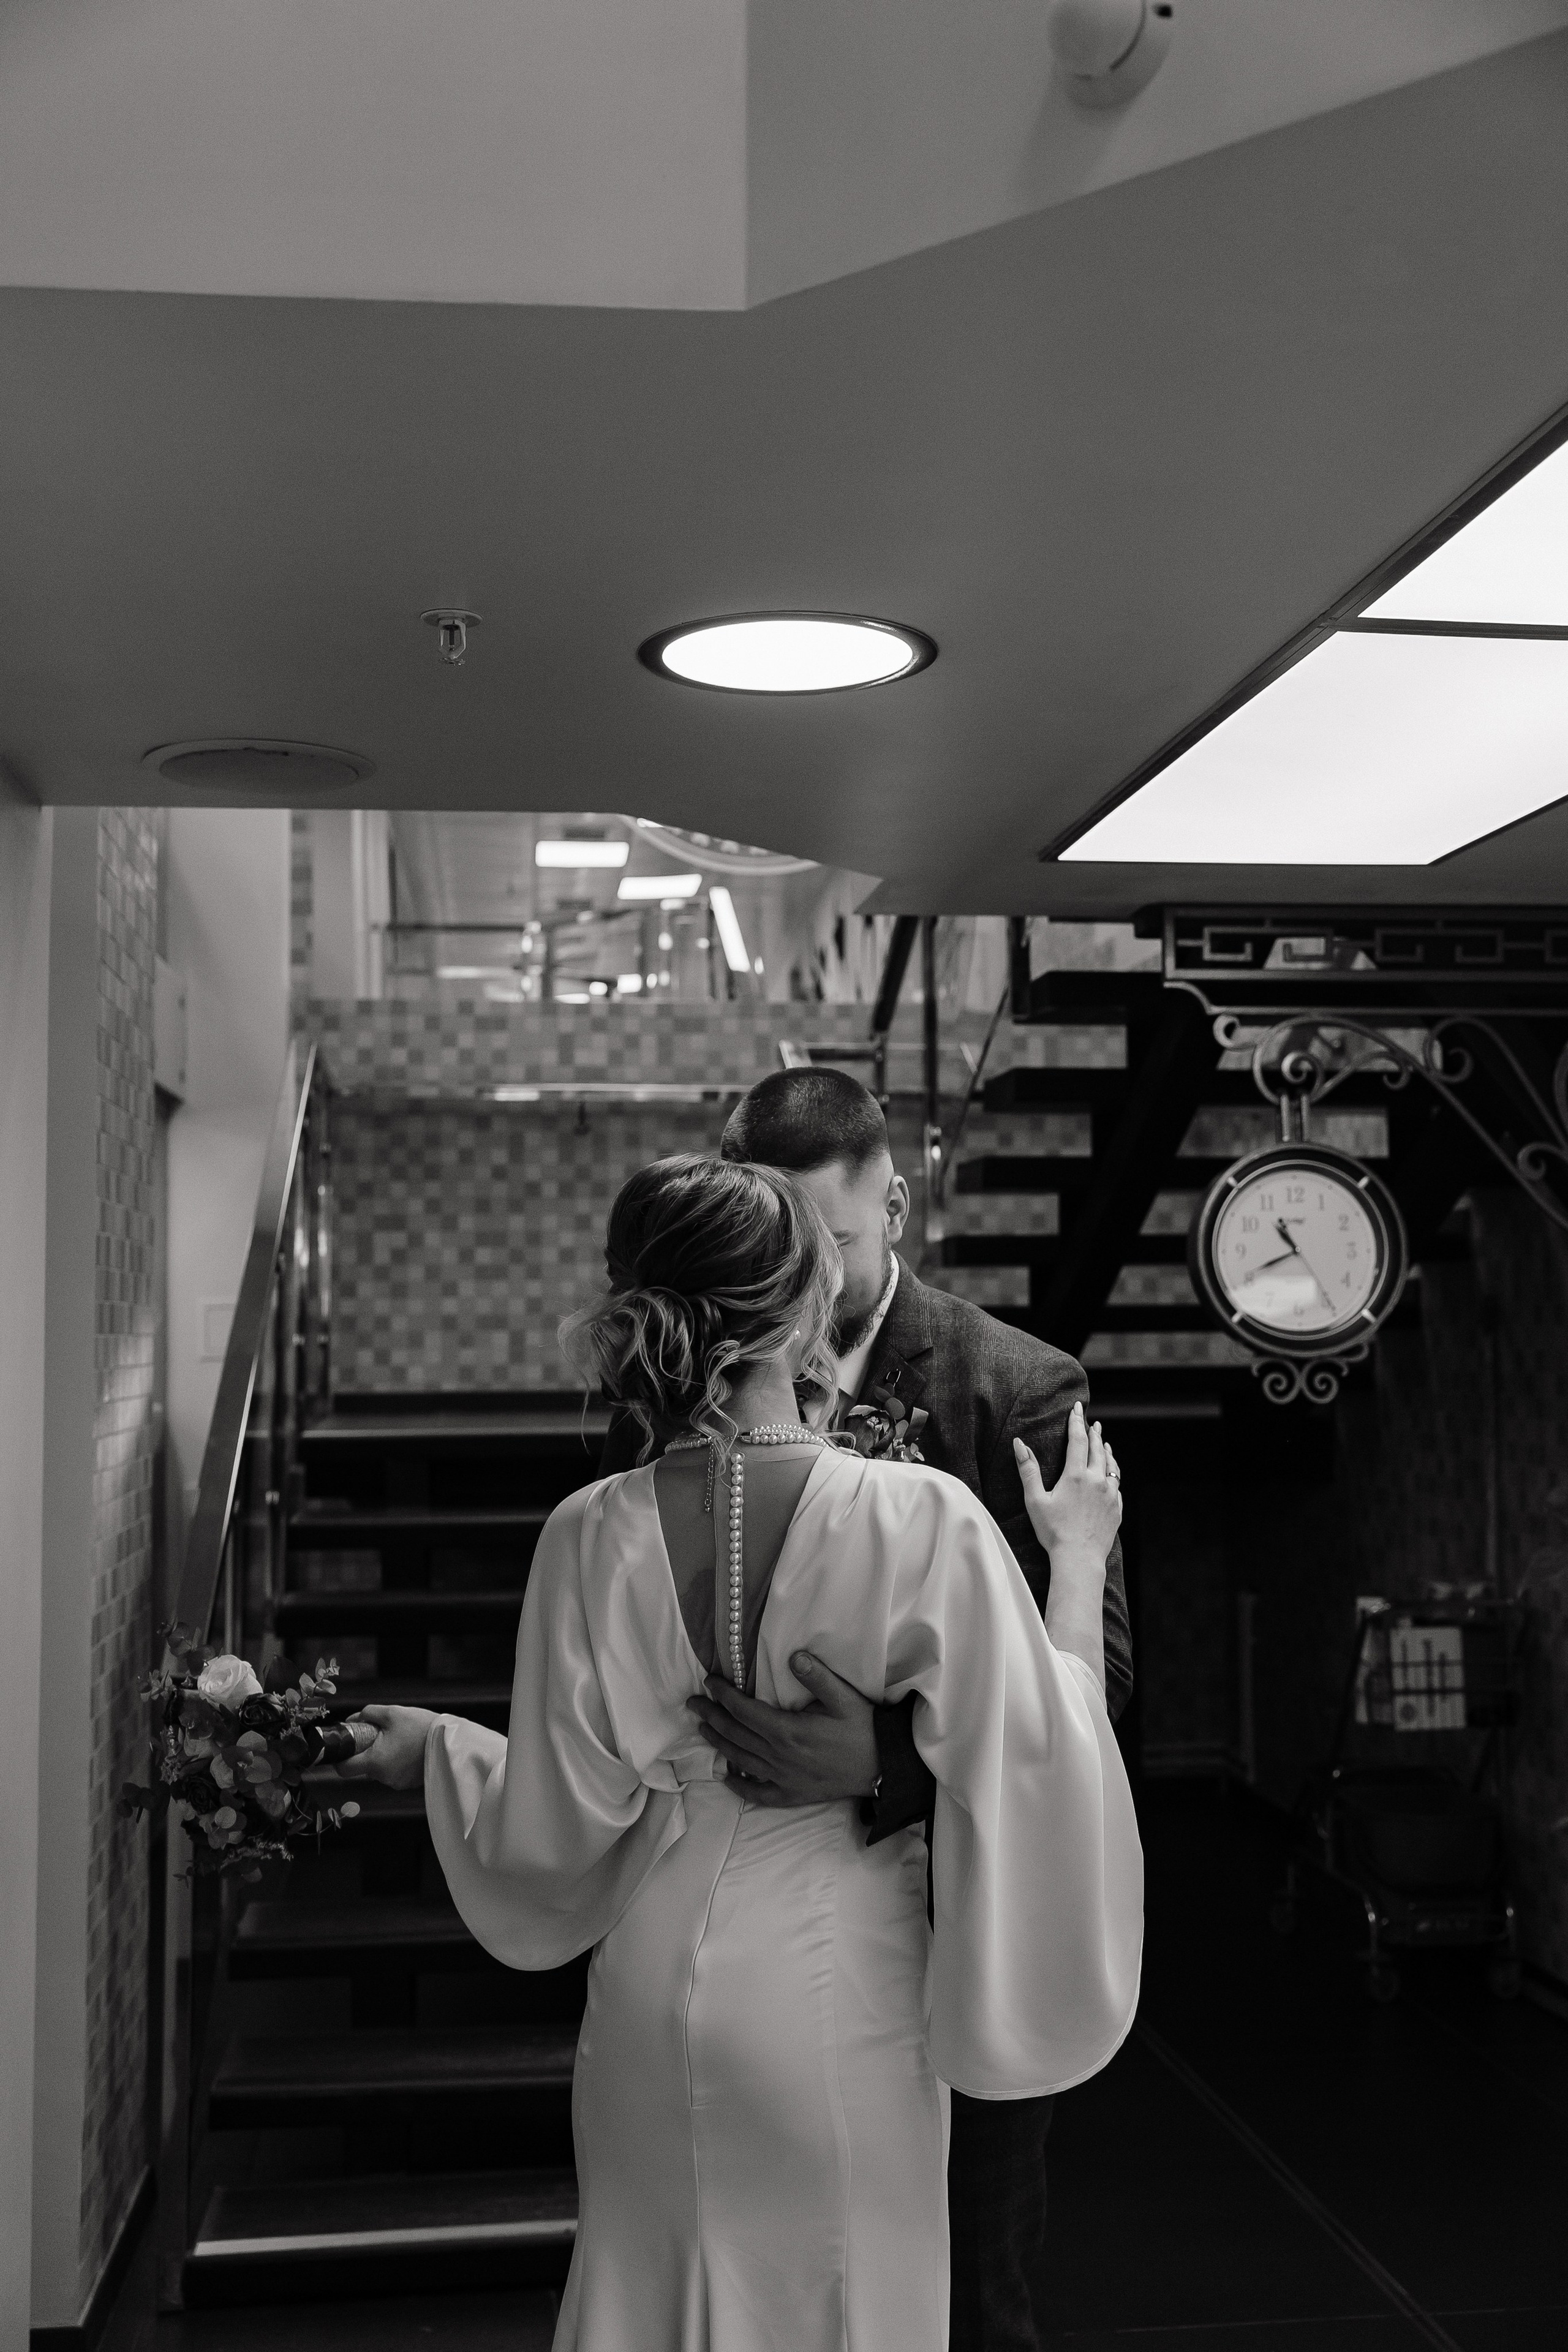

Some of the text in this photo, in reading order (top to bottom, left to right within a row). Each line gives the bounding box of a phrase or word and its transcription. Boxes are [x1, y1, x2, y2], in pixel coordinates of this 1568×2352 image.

[1261, 1194, 1275, 1212] 11
[1286, 1186, 1305, 1204] 12
[1318, 1194, 1325, 1212] 1
[1242, 1215, 1260, 1234] 10
[1338, 1213, 1350, 1232] 2
[1235, 1243, 1247, 1260] 9
[1347, 1241, 1357, 1261] 3
[1340, 1270, 1351, 1289] 4
[1265, 1291, 1275, 1308] 7
